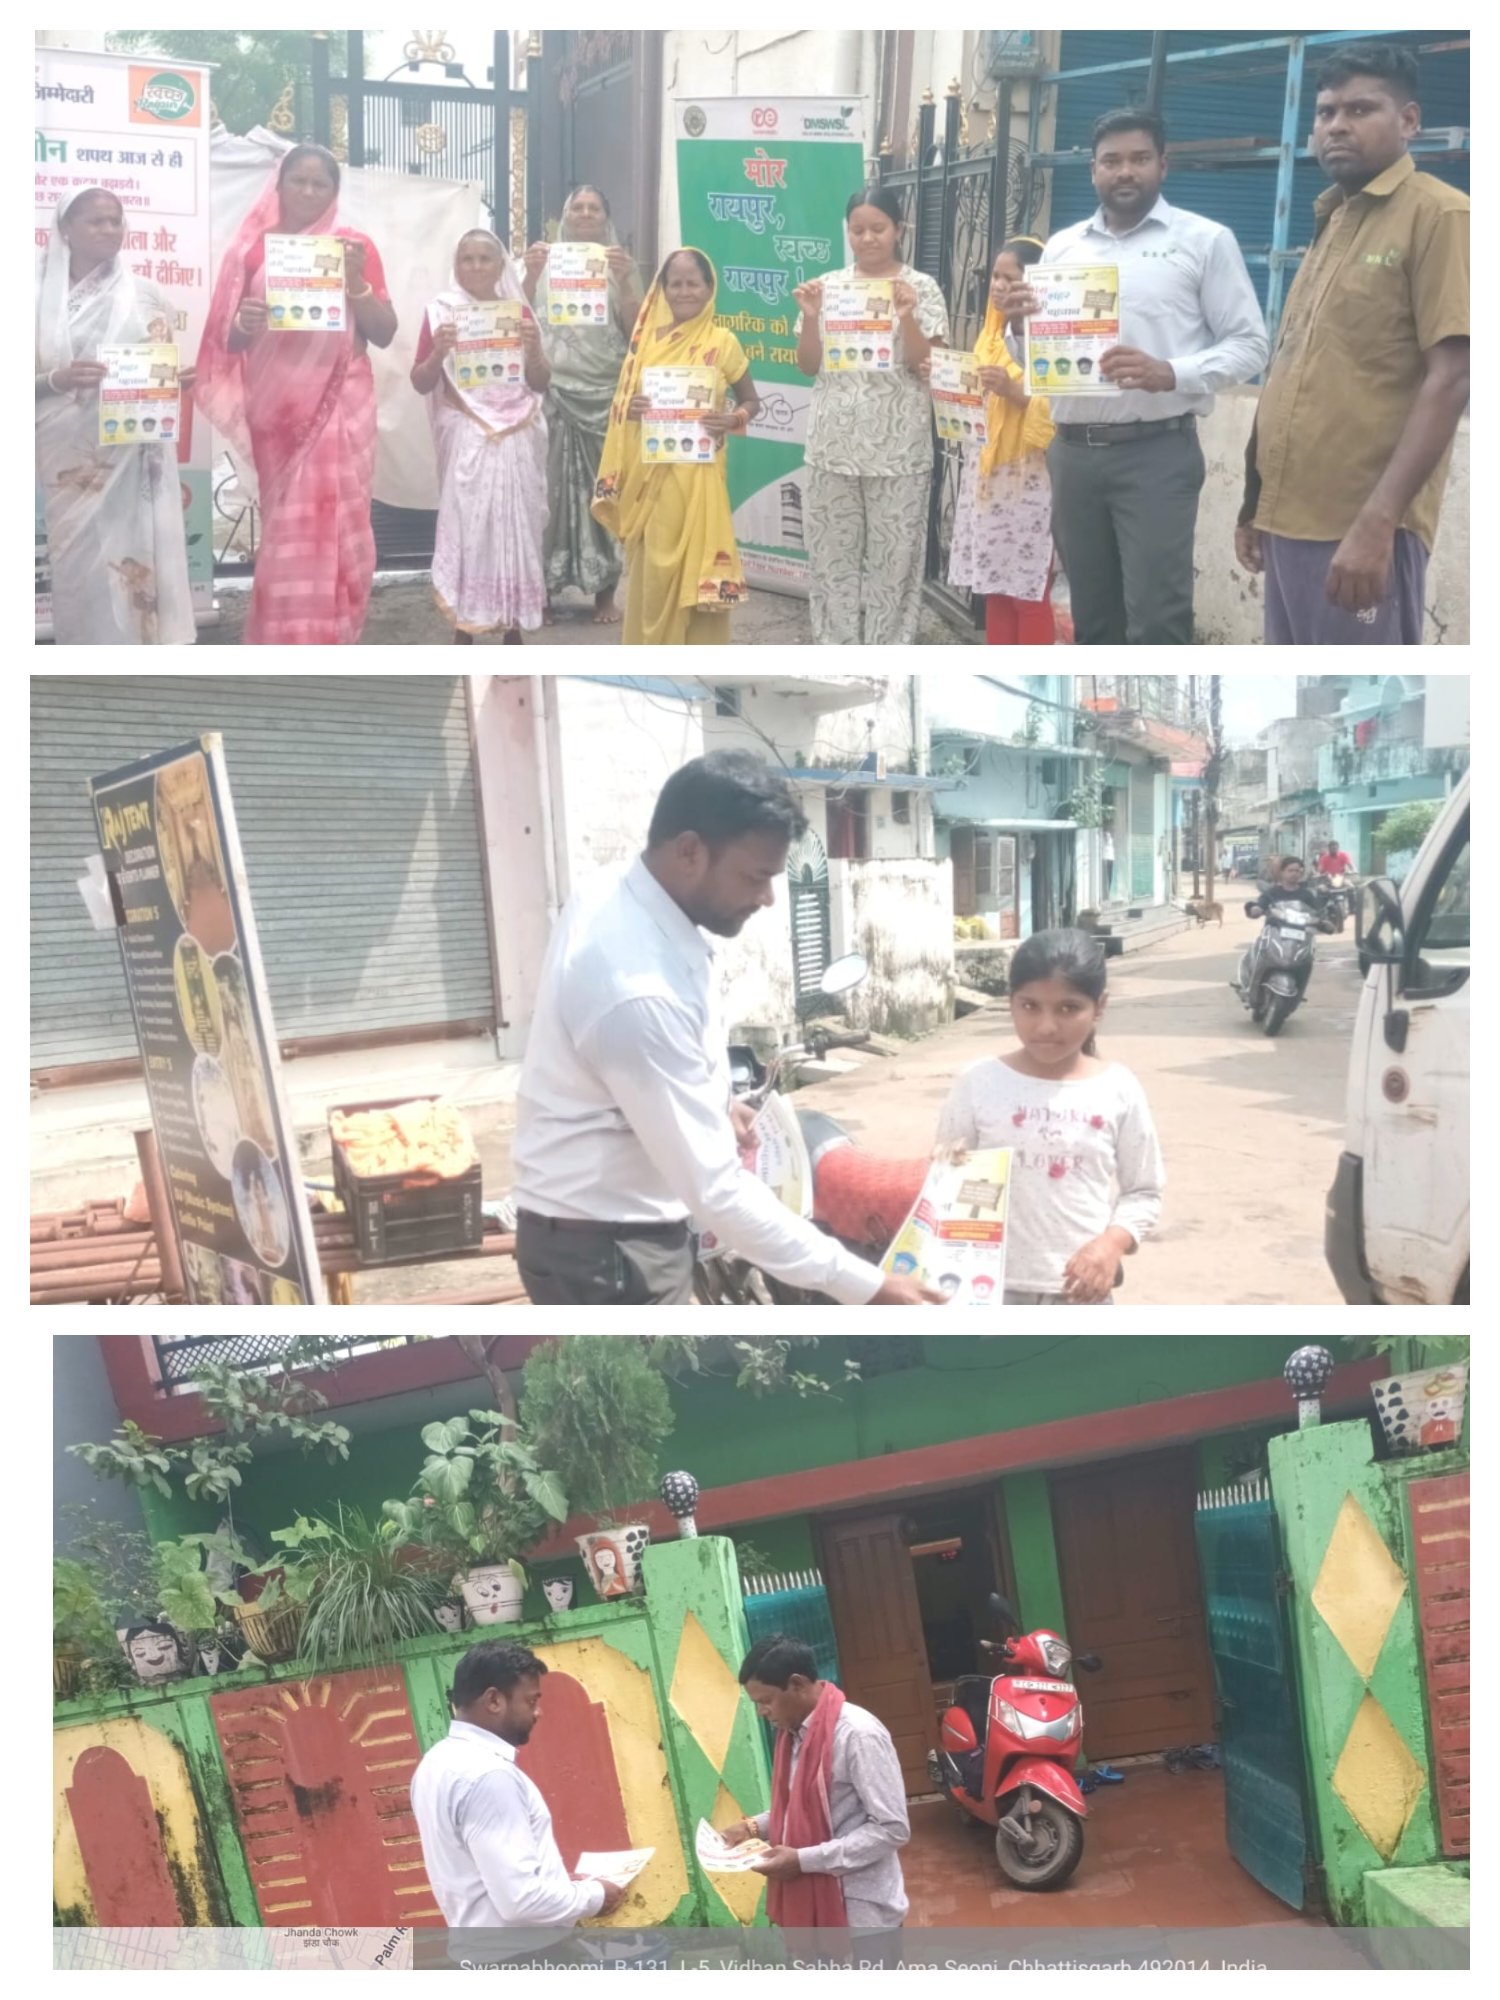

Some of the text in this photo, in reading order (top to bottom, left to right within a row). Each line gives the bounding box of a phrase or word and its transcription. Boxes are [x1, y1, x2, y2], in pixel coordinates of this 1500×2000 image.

[76, 148, 113, 163] शपथ
[118, 151, 146, 166] आज
[151, 149, 164, 167] से
[169, 150, 183, 168] ही
[743, 147, 788, 188] मोर
[153, 225, 177, 253] और
[723, 265, 789, 306] रायपुर
[769, 314, 789, 337] को
